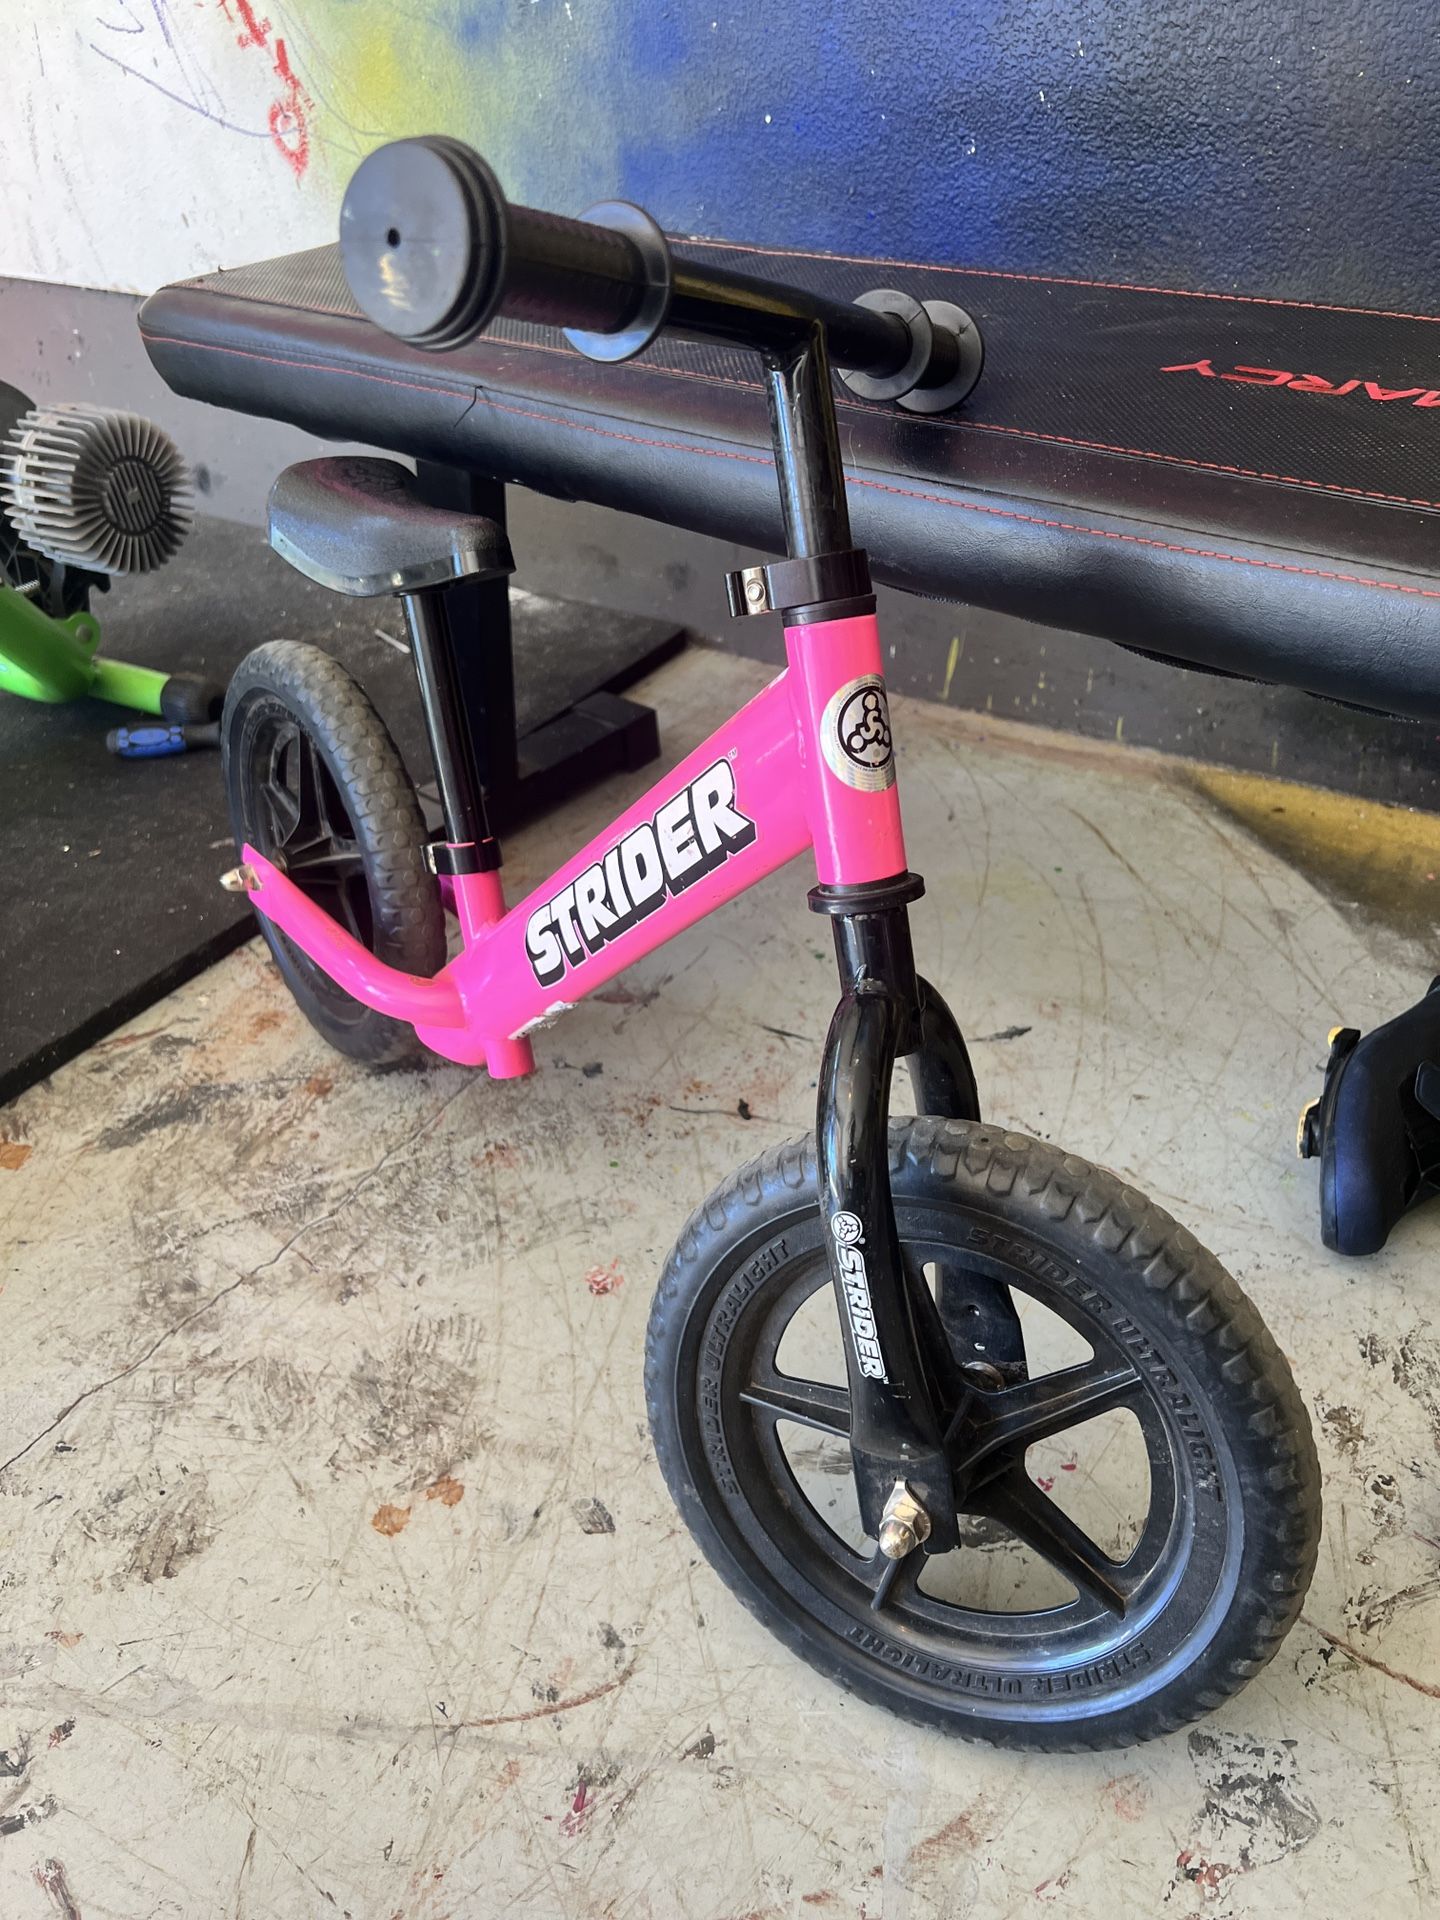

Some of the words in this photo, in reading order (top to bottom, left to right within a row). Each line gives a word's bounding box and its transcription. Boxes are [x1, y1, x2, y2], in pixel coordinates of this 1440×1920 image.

[526, 757, 756, 988] STRIDER
[703, 1238, 790, 1371] ULTRALIGHT
[836, 1241, 886, 1379] STRIDER
[966, 1226, 1113, 1315] STRIDER
[702, 1375, 741, 1496] STRIDER
[1029, 1641, 1151, 1695] STRIDER
